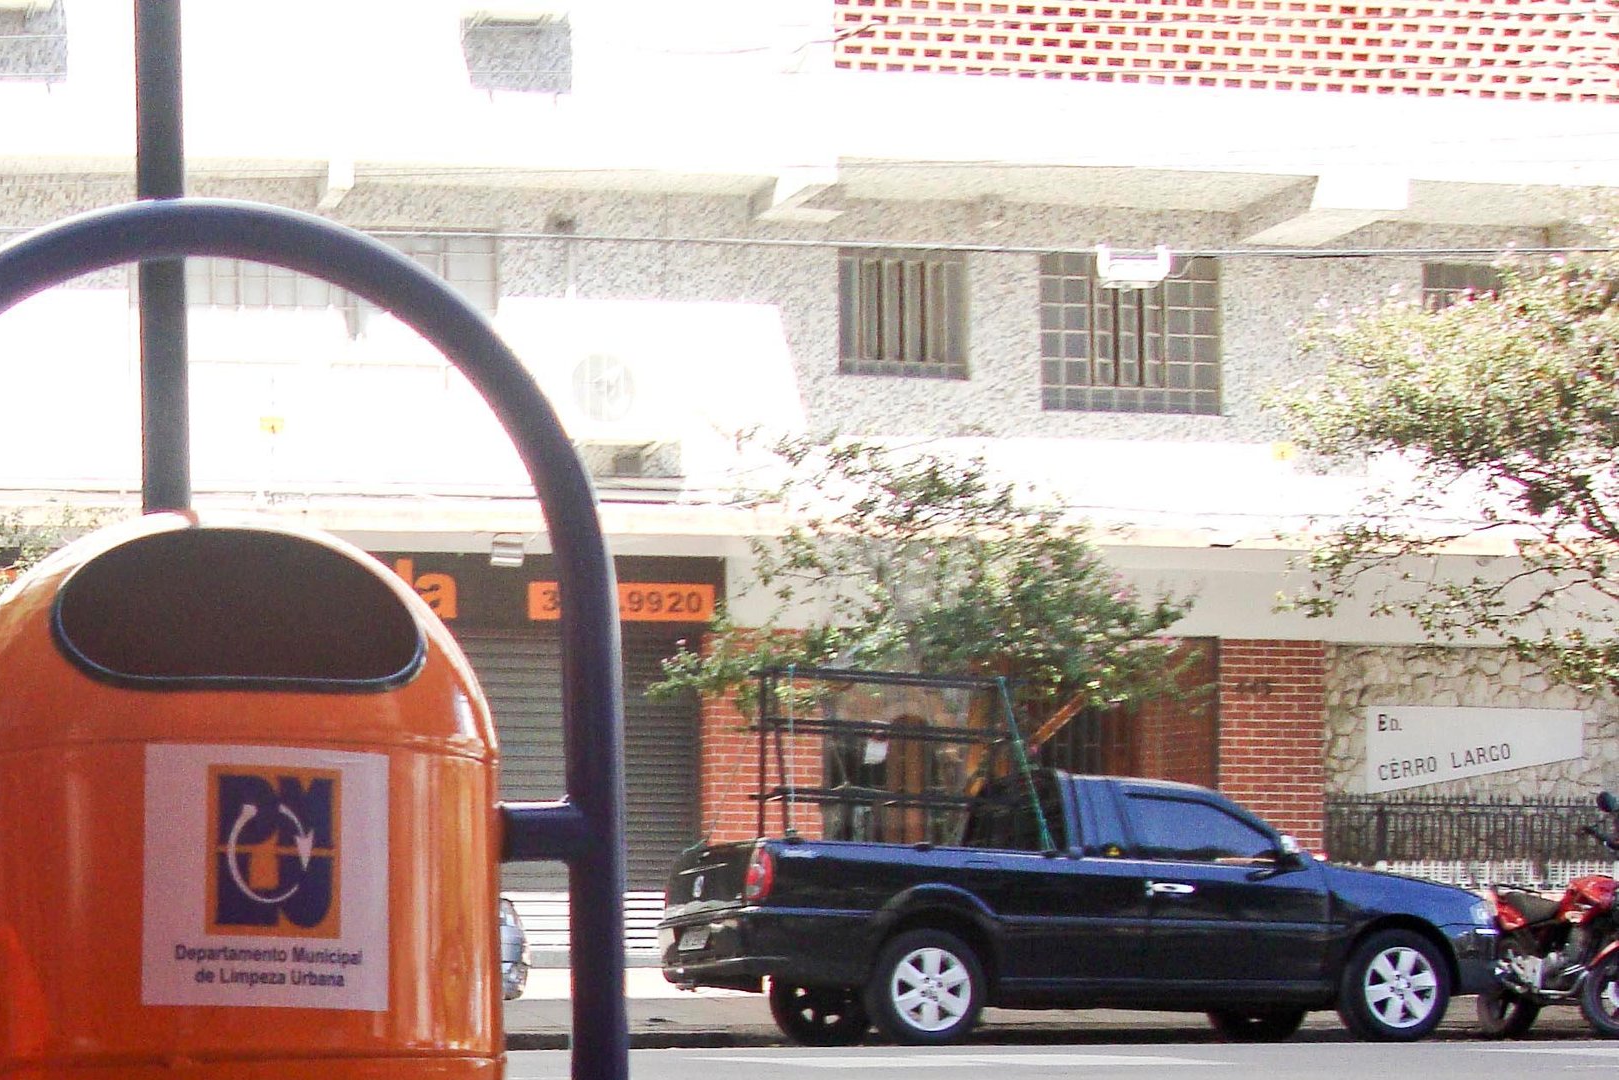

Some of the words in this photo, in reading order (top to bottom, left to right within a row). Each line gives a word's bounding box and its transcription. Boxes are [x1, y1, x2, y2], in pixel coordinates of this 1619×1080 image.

[1450, 743, 1511, 769] LARGO
[175, 943, 288, 963] Departamento
[292, 946, 363, 967] Municipal
[195, 968, 216, 983] de
[220, 968, 286, 987] Limpeza
[291, 970, 346, 987] Urbana
